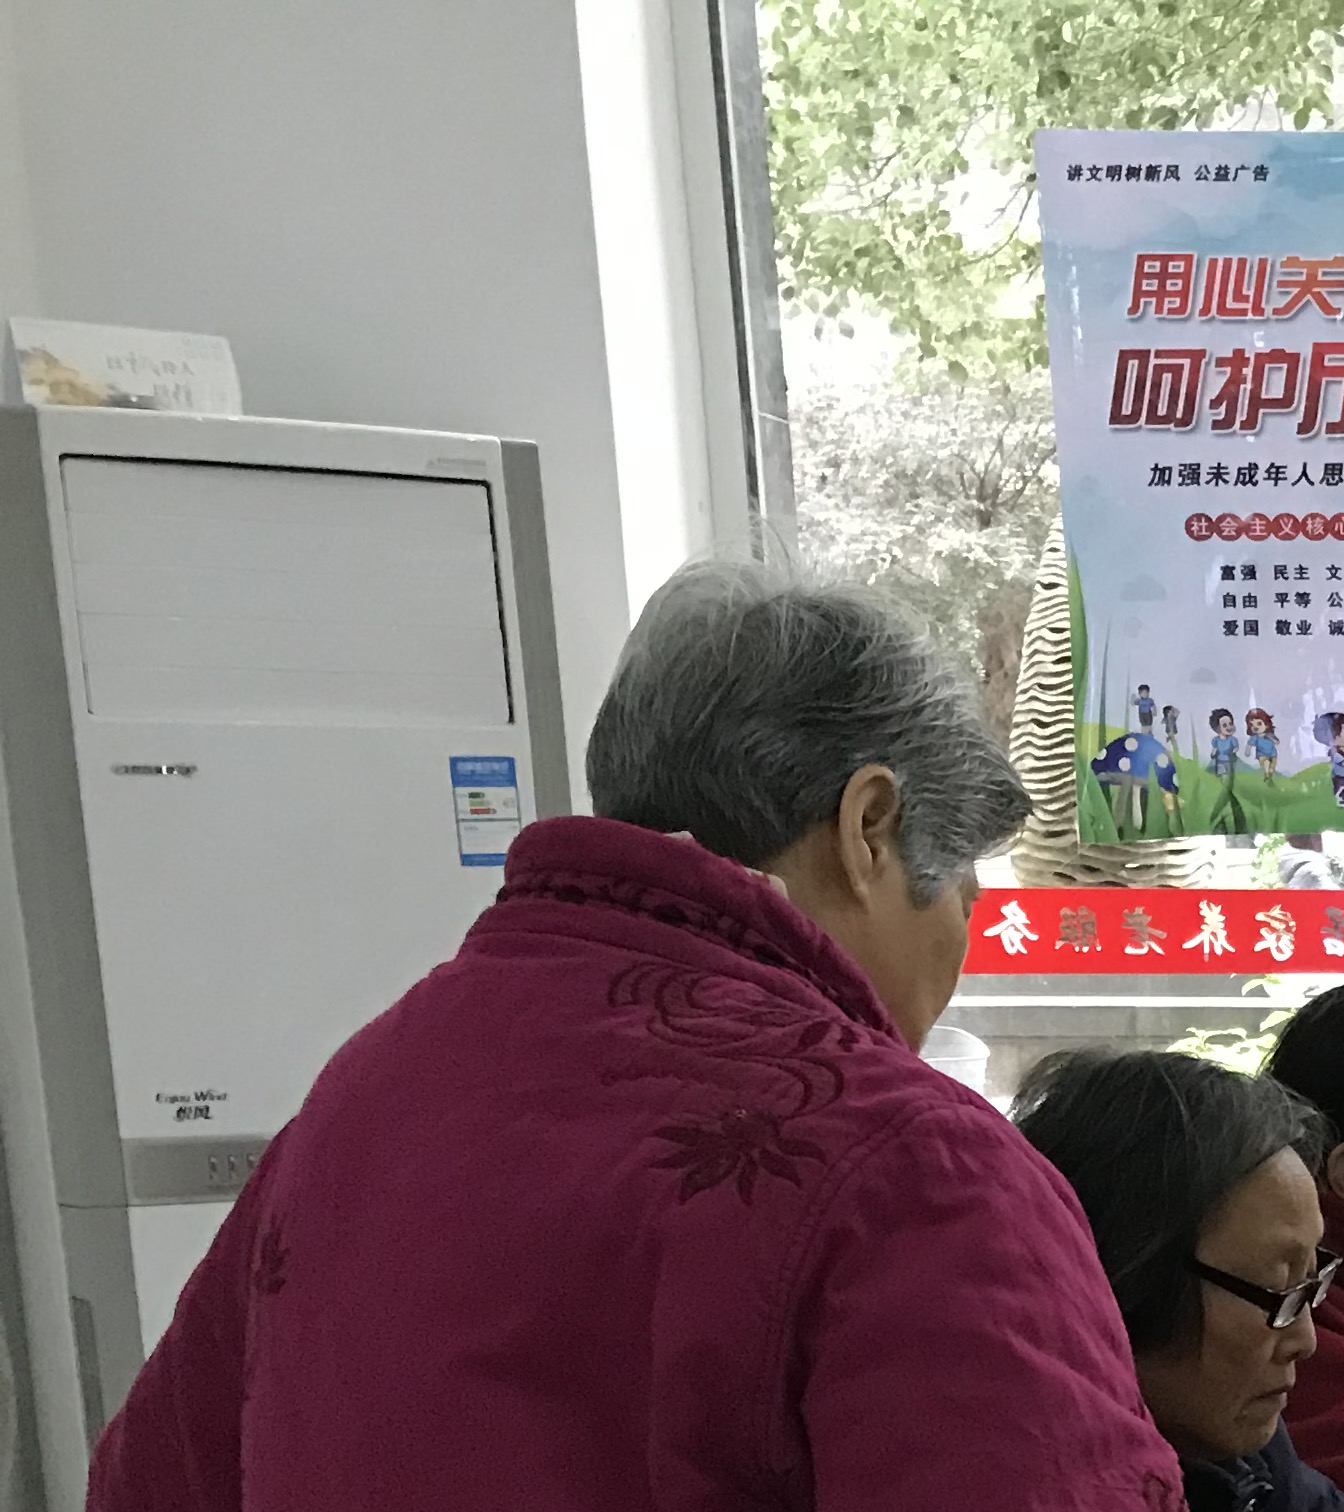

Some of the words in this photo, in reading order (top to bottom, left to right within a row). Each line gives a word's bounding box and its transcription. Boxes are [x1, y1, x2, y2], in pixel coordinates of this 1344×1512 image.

[1066, 163, 1182, 183] 讲文明树新风
[1193, 163, 1270, 183] 公益广告
[1219, 563, 1258, 582] 富强
[1273, 563, 1311, 582] 民主
[1222, 591, 1258, 609] 自由
[1273, 591, 1312, 609] 平等
[1222, 619, 1260, 637] 爱国
[1274, 619, 1313, 637] 敬业
